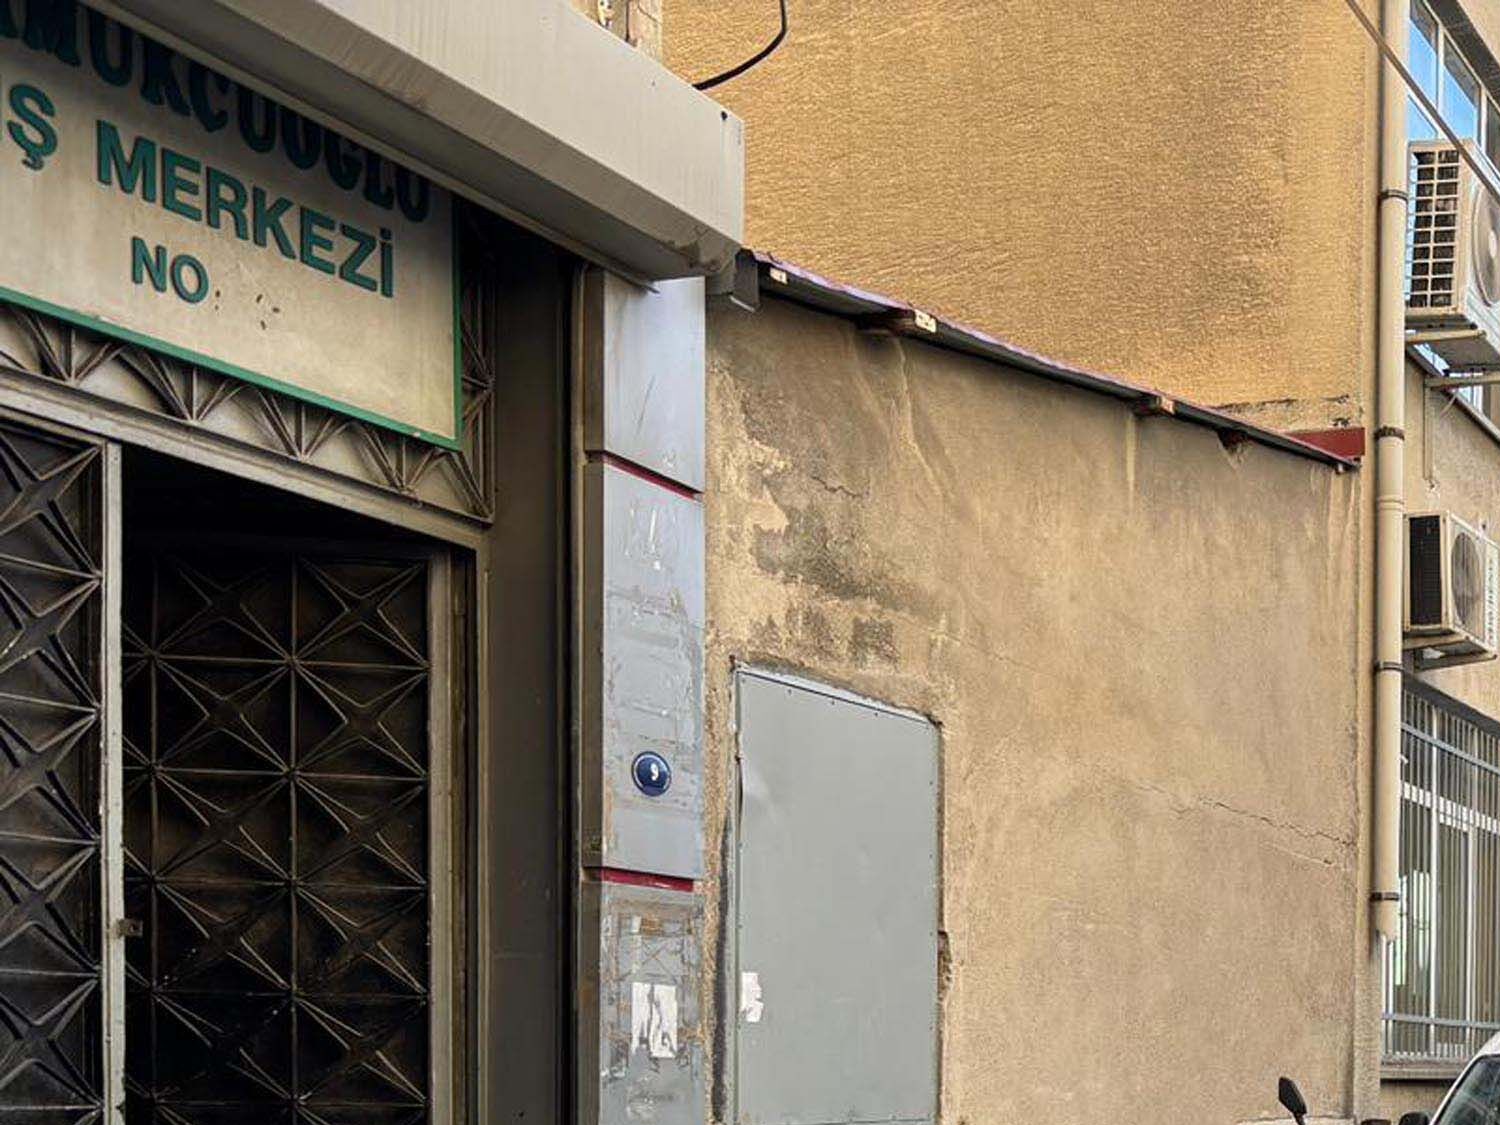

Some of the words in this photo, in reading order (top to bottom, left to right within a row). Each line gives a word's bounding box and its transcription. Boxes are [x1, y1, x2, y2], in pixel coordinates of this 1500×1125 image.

[0, 83, 58, 171] Ş
[96, 119, 394, 298] MERKEZİ
[131, 236, 209, 304] NO
